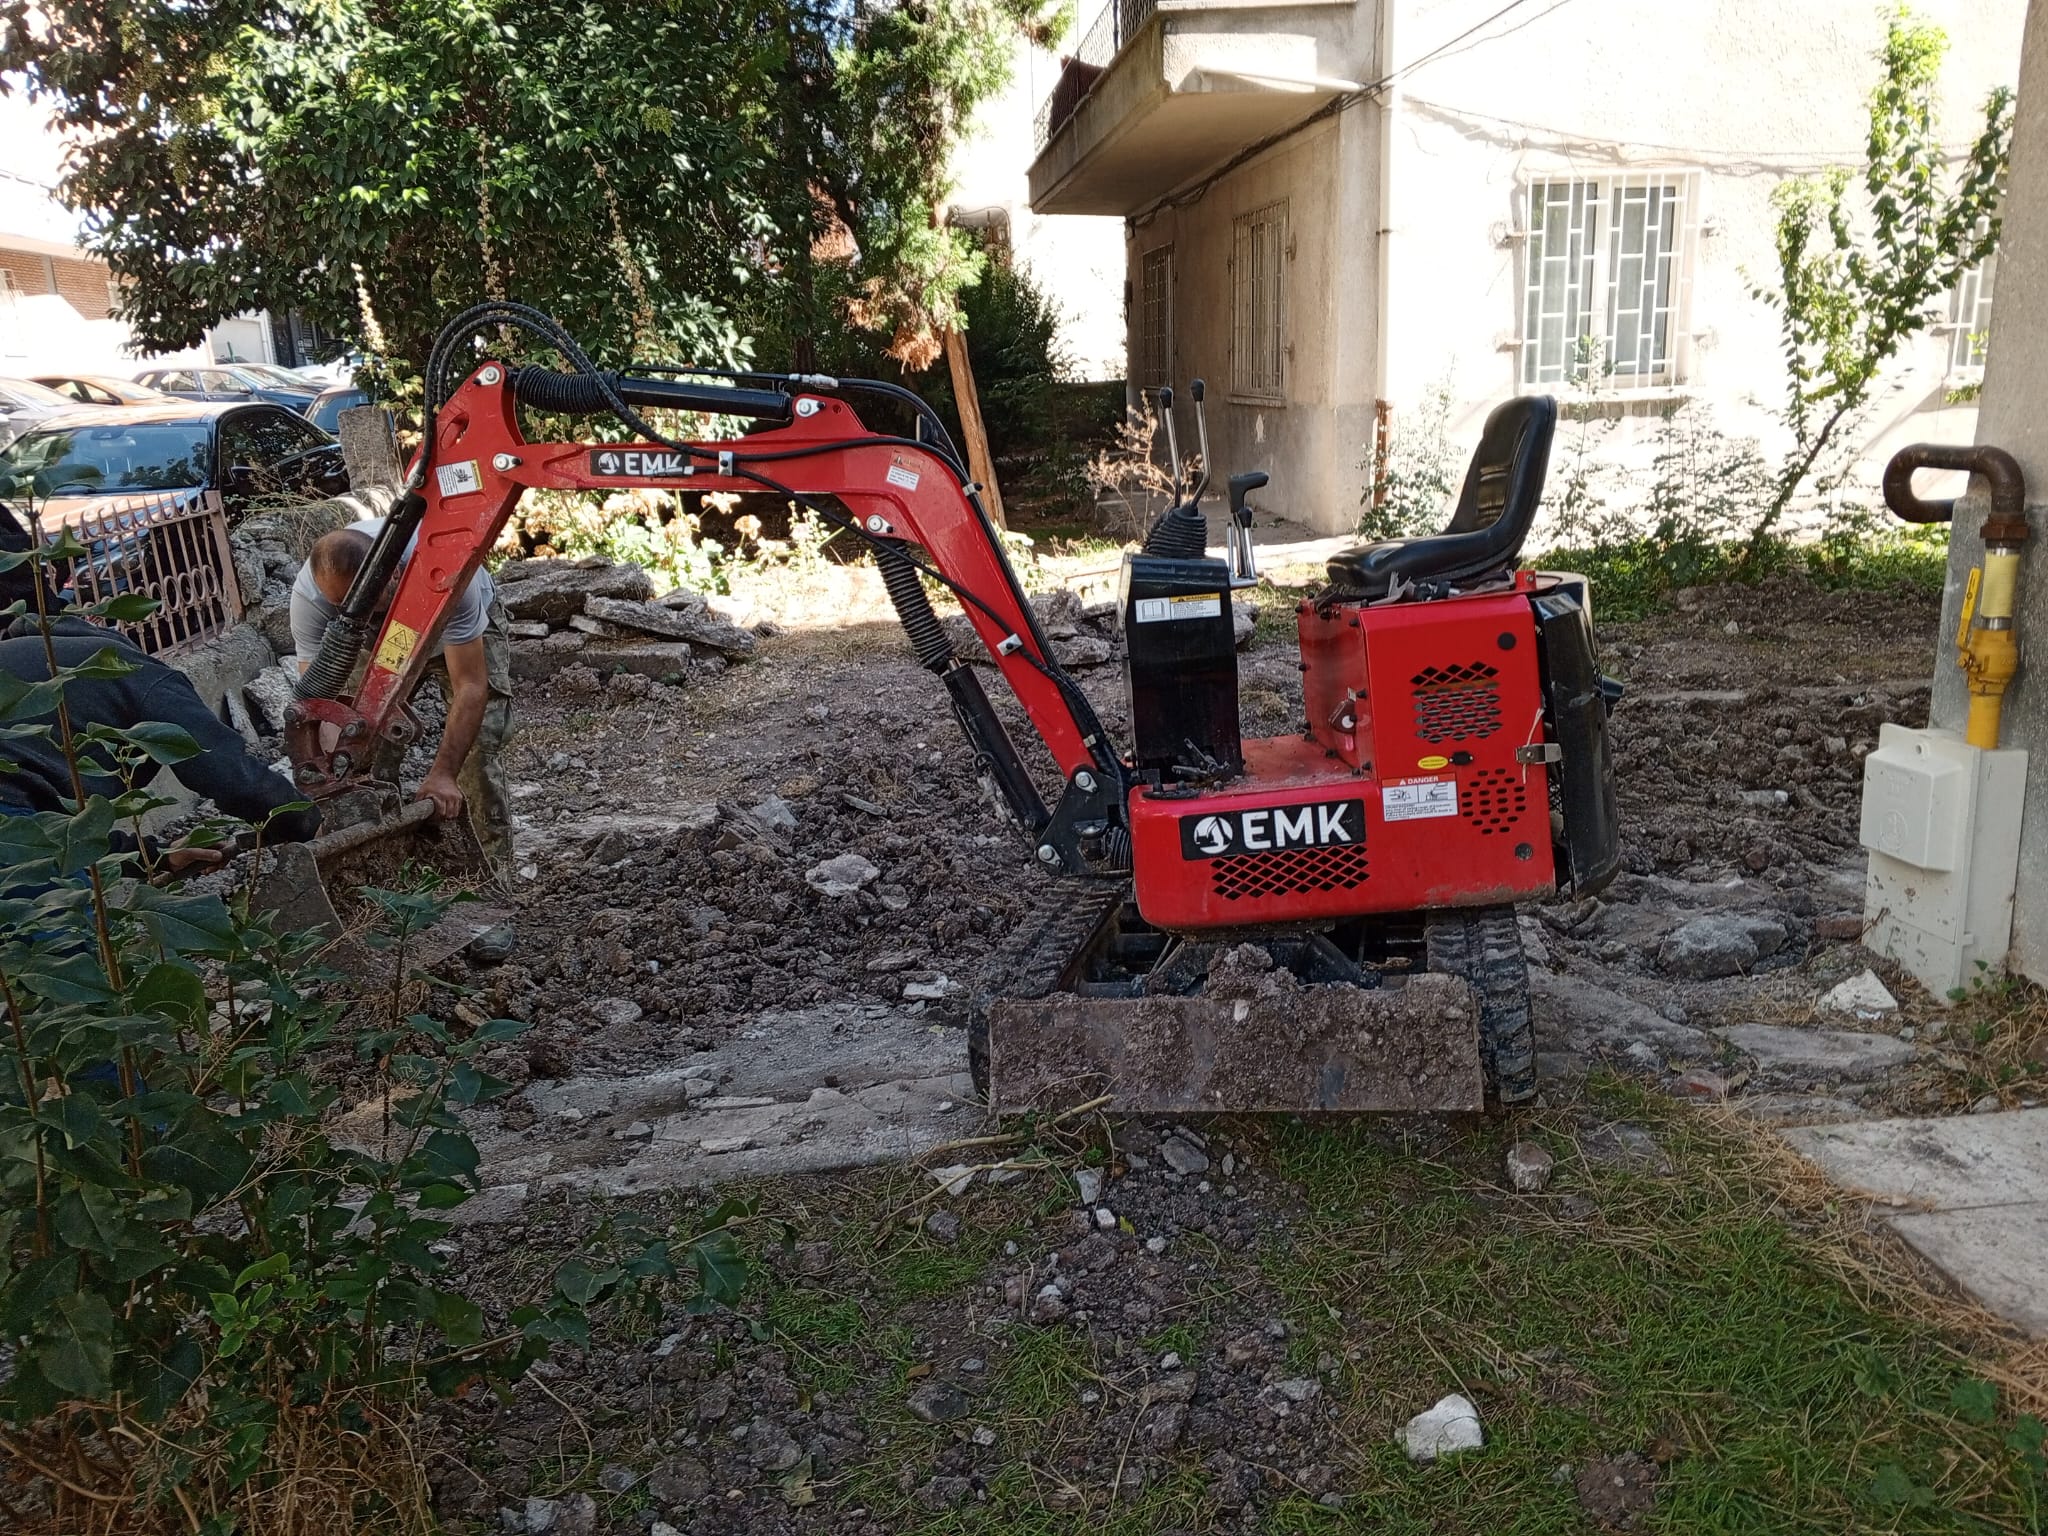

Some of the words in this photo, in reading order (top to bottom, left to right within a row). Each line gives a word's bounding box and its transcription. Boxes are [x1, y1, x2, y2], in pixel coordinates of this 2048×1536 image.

[625, 453, 683, 475] EMK
[1407, 776, 1439, 785] DANGER
[1242, 803, 1352, 850] EMK
